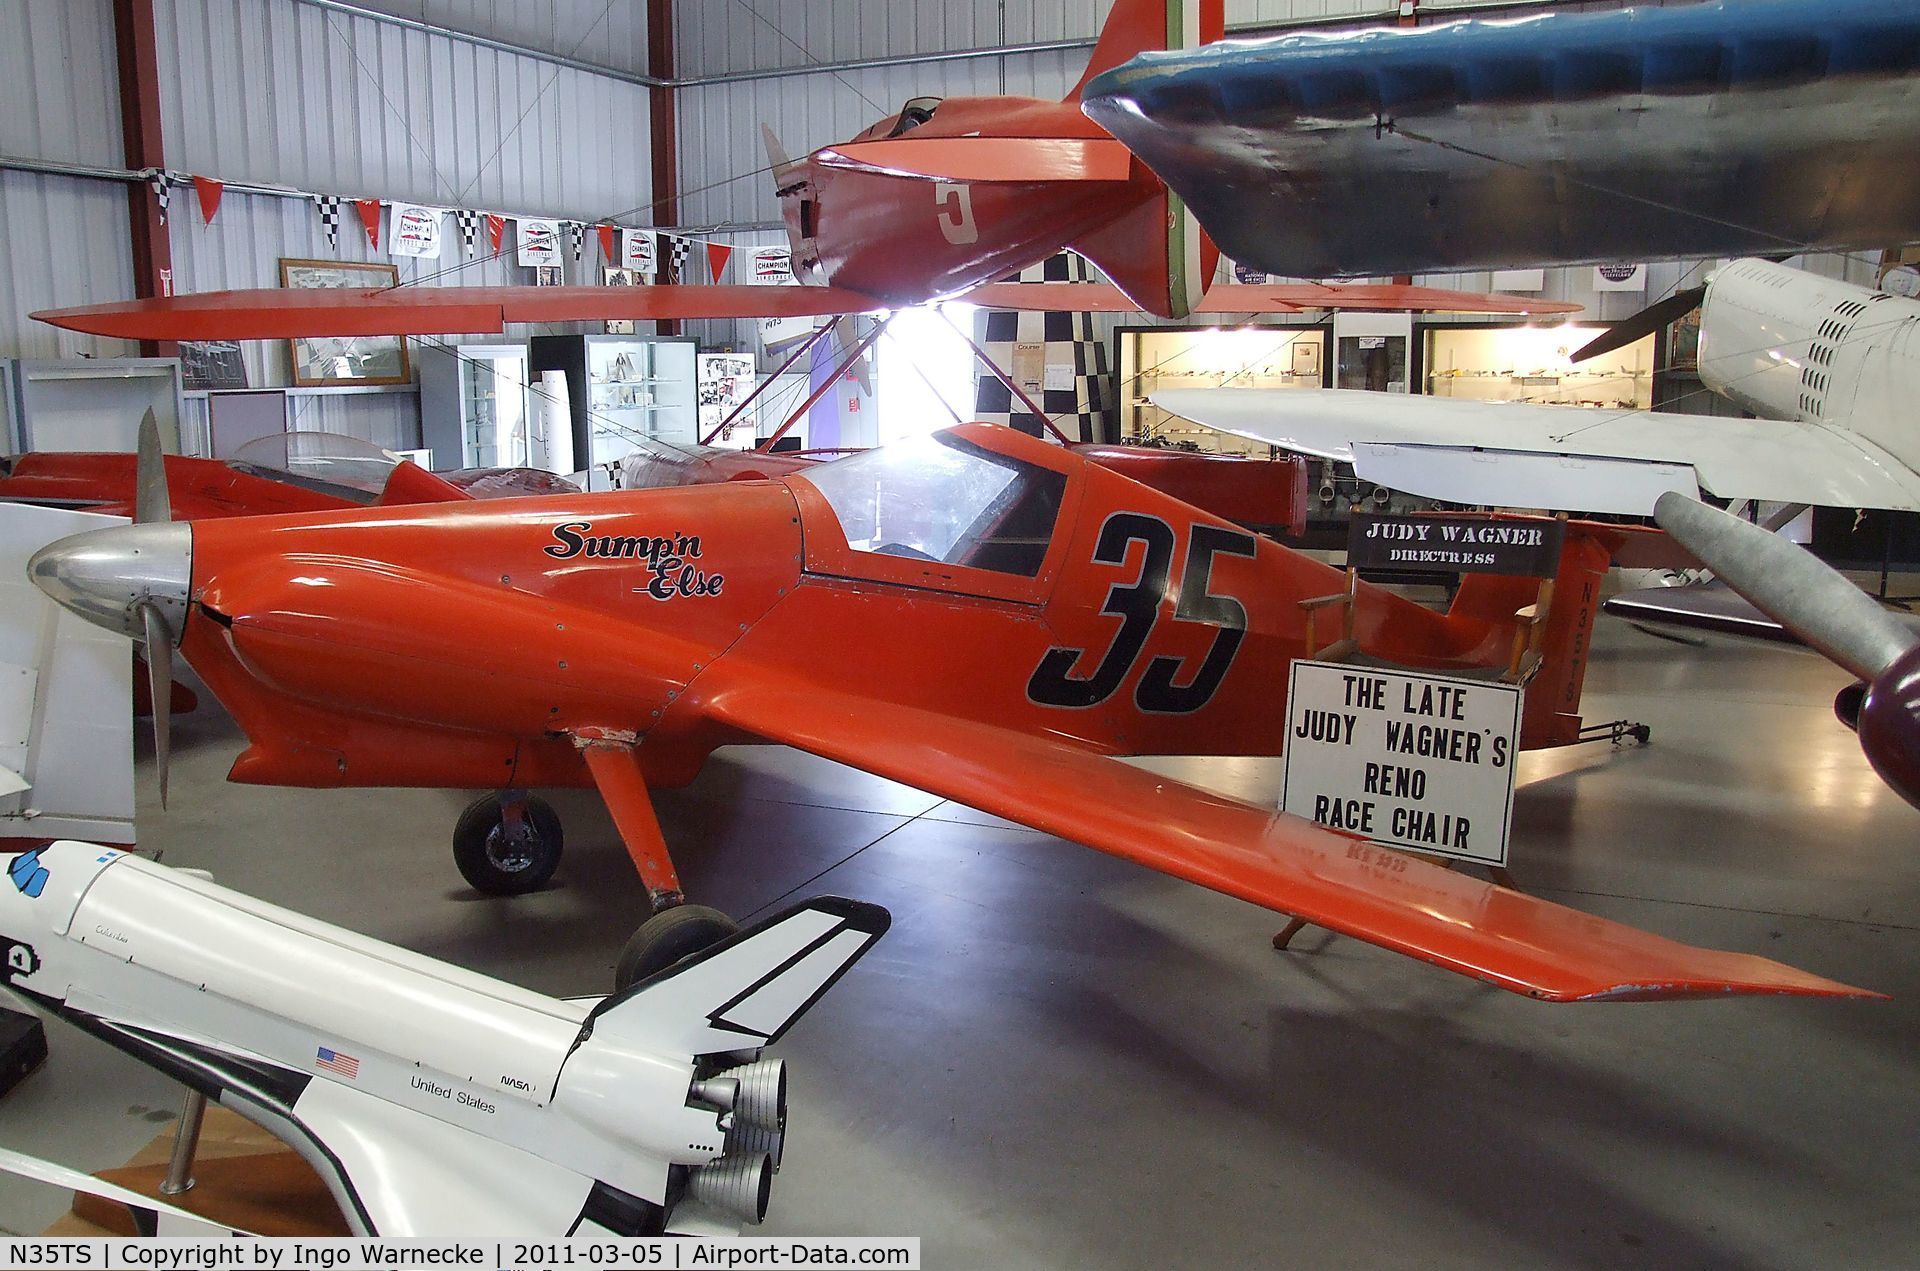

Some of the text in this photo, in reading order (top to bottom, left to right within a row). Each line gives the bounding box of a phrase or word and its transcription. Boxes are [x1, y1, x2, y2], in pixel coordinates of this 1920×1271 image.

[757, 262, 788, 270] CHAMPION
[543, 521, 703, 570] Sump'n
[1366, 522, 1543, 546] JUDY WAGNER
[1390, 549, 1495, 565] DIRECTRESS
[632, 557, 724, 602] Else
[1026, 510, 1257, 715] 35
[1343, 675, 1467, 721] THE LATE
[1295, 709, 1508, 768] JUDY WAGNER'S
[1364, 762, 1427, 800] RENO
[1314, 794, 1470, 850] RACE CHAIR
[410, 1075, 496, 1115] United States
[501, 1075, 530, 1092] NASA
